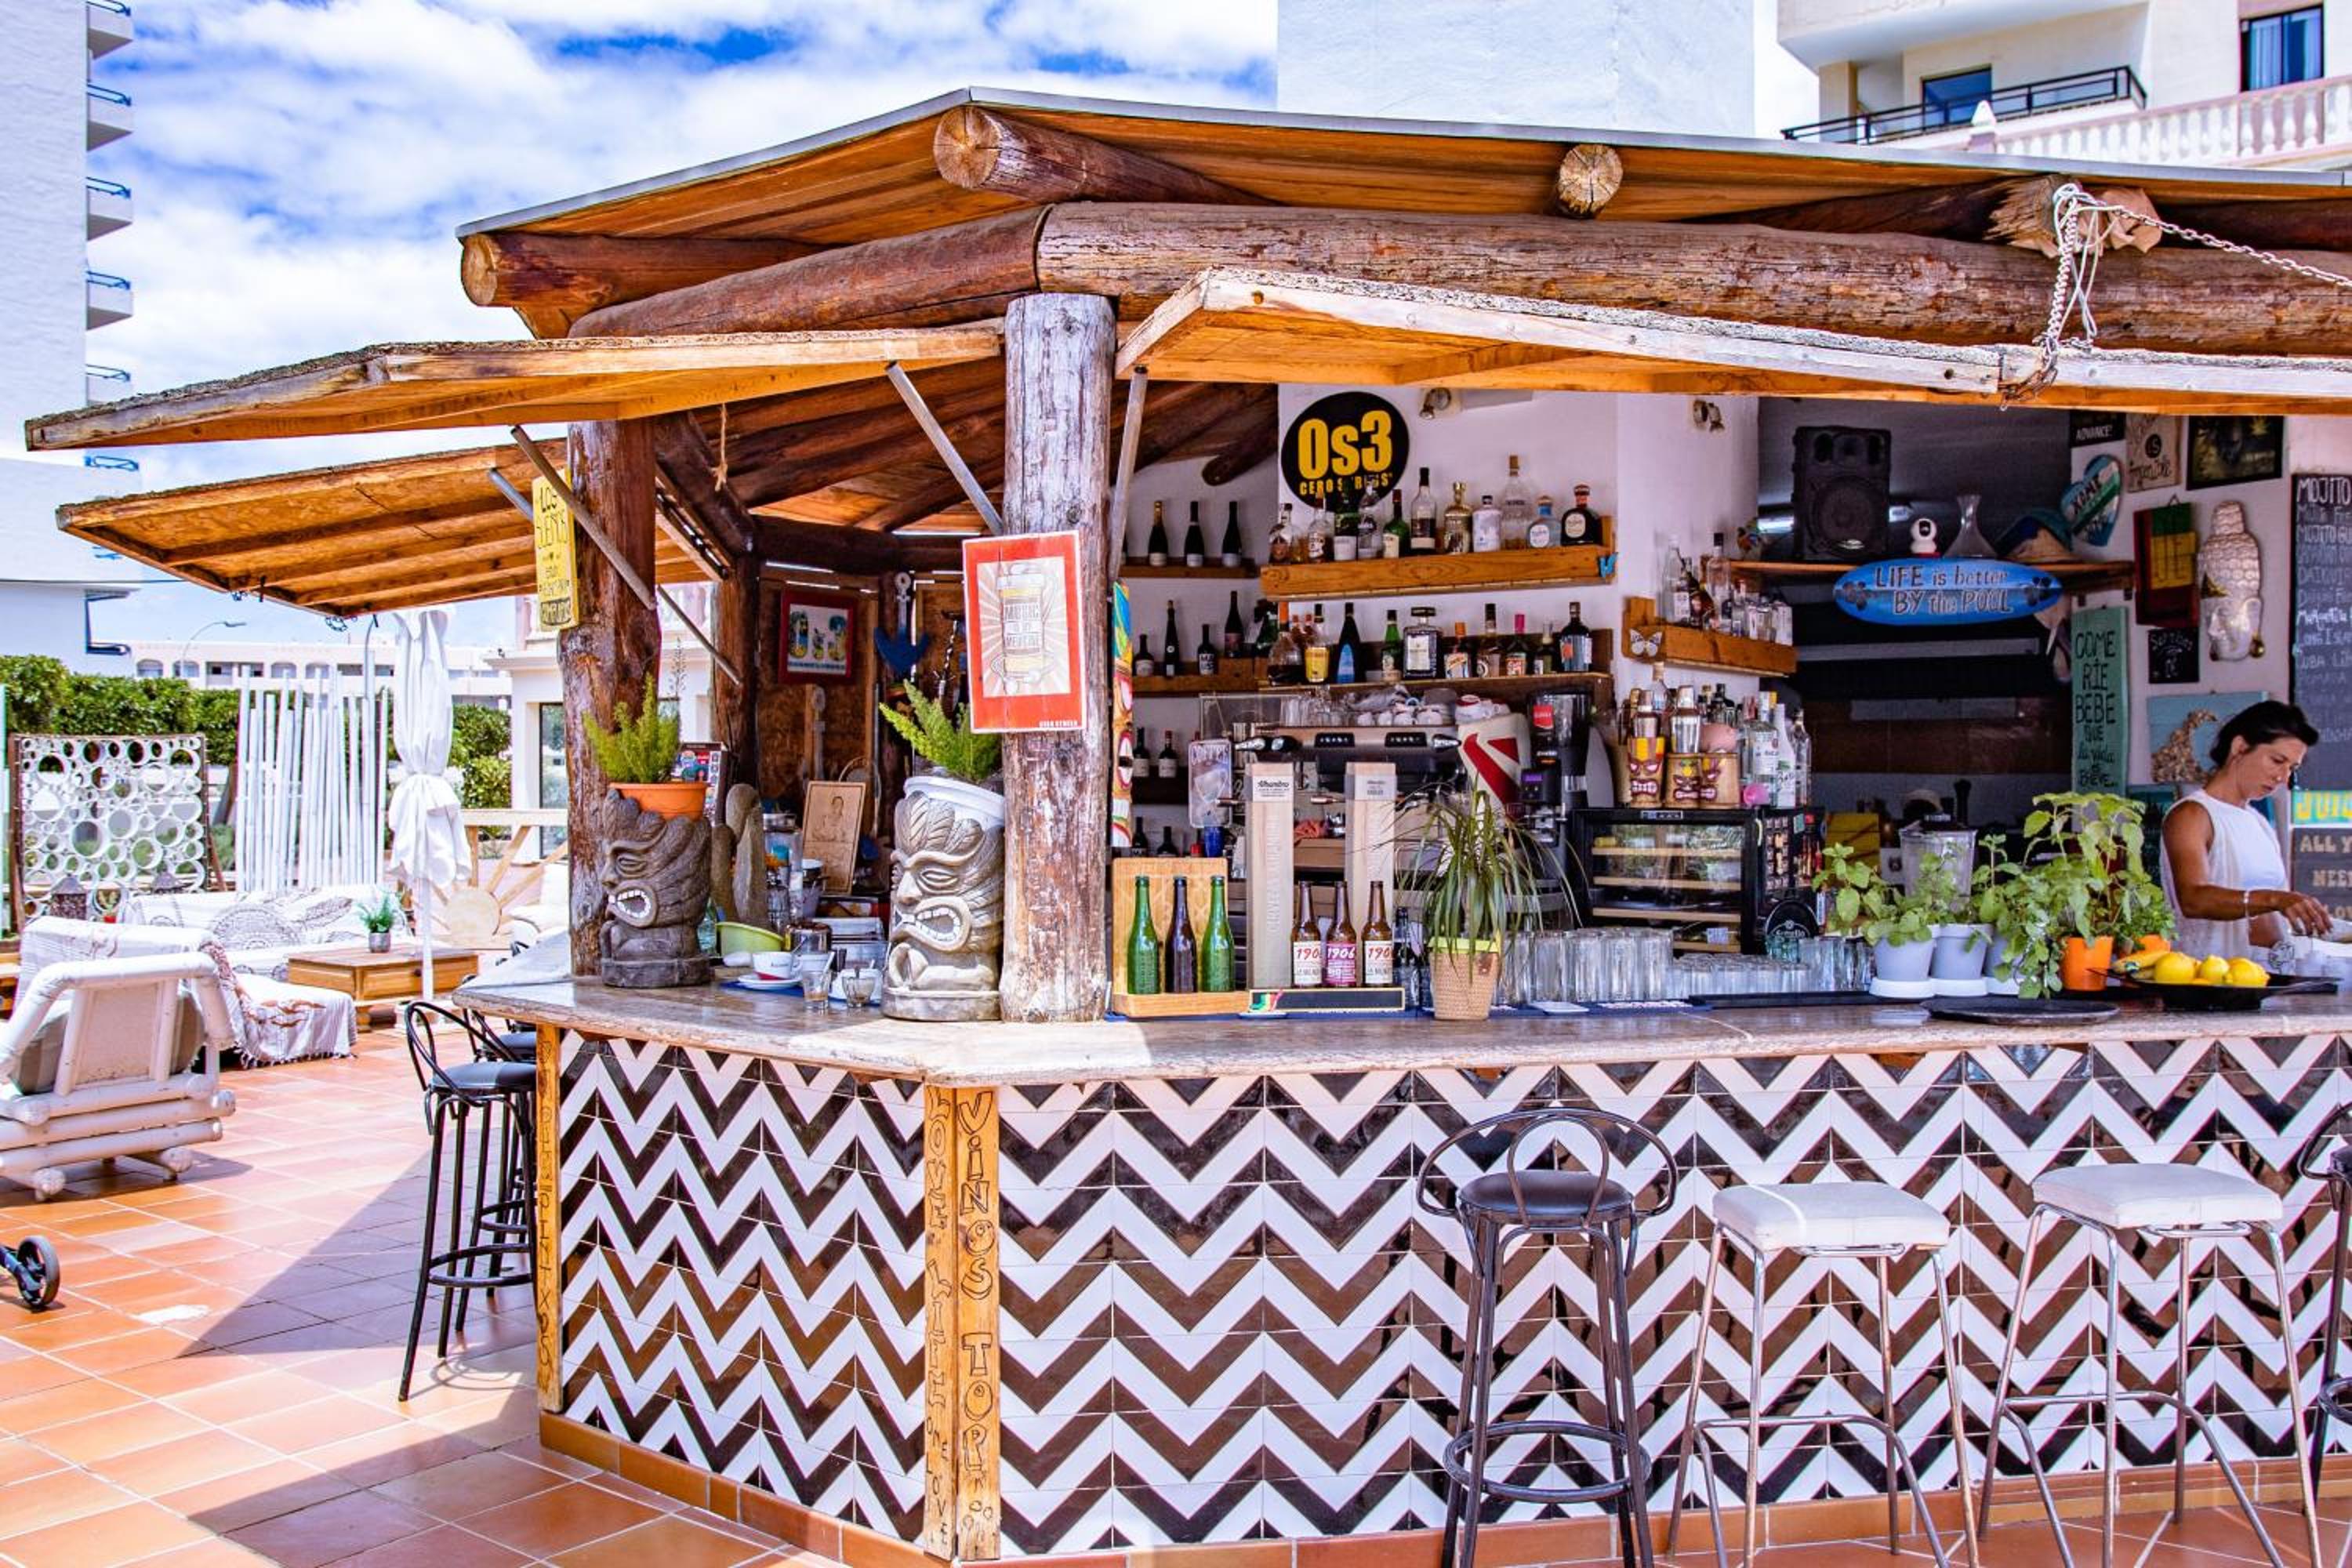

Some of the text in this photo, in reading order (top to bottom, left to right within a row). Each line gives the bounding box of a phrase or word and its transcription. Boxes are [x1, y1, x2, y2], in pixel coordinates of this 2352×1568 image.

[1875, 565, 2007, 586] LIFE is better
[1893, 588, 2013, 614] BY the POOL
[2075, 630, 2115, 659] COME
[2075, 693, 2116, 724] BEBE
[2300, 835, 2336, 853] ALL
[1327, 947, 1356, 959] 1906
